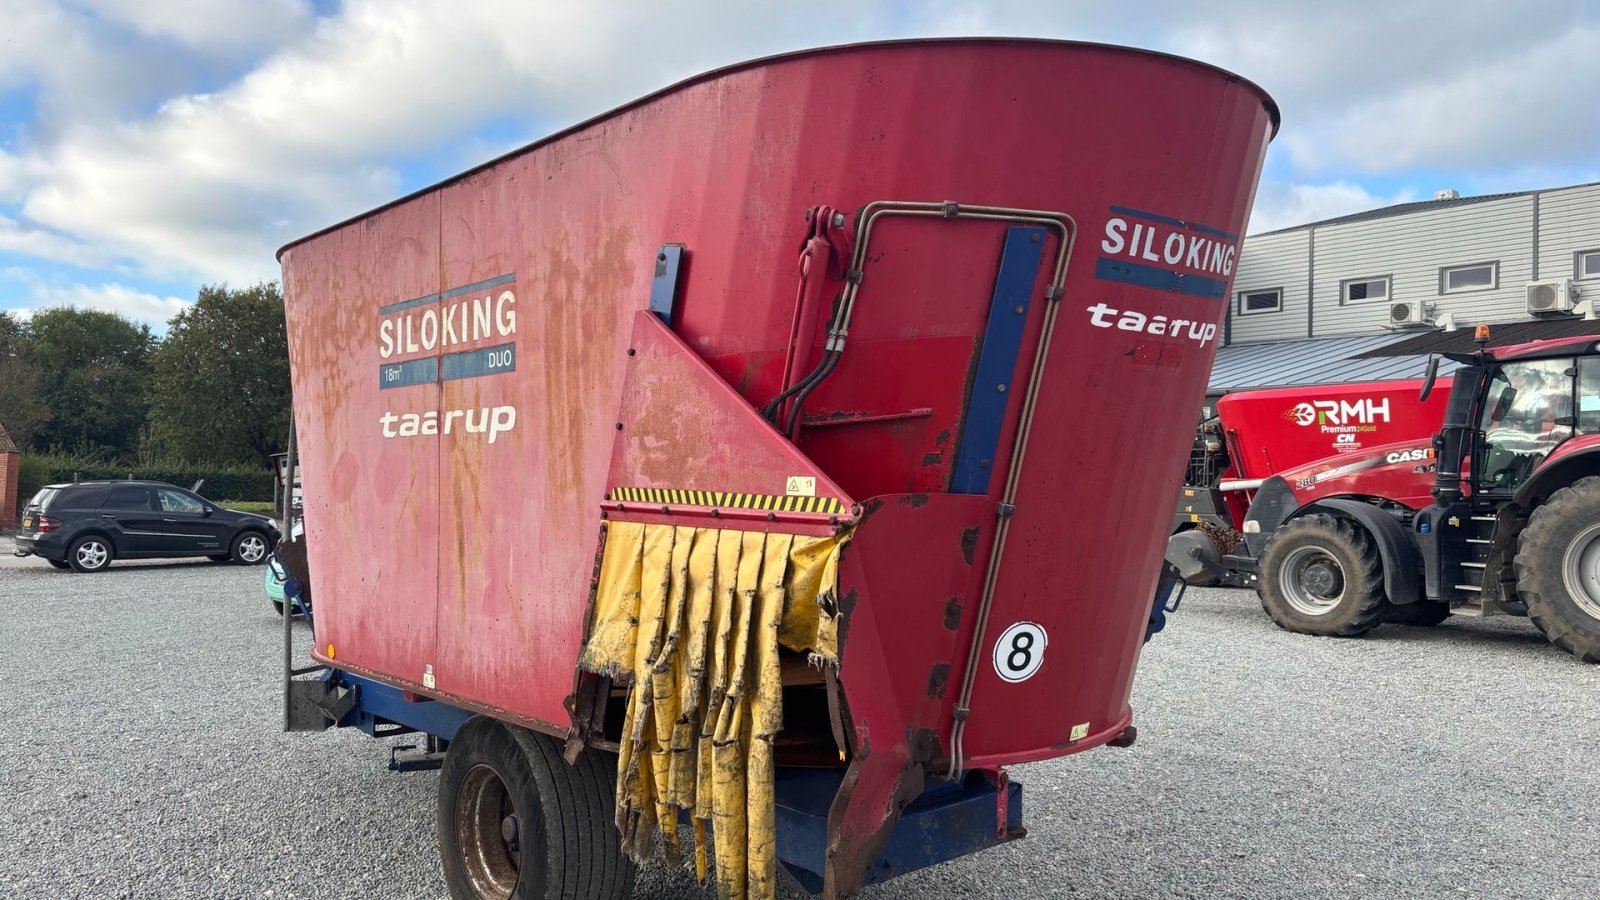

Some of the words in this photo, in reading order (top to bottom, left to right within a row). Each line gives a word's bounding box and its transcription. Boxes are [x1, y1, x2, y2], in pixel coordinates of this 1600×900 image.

[1101, 218, 1235, 277] SILOKING
[379, 290, 517, 359] SILOKING
[1086, 302, 1217, 348] taarup
[488, 350, 512, 368] DUO
[379, 405, 517, 444] taarup
[1313, 397, 1391, 425] RMH
[1296, 474, 1316, 490] 280
[1007, 631, 1034, 672] 8
